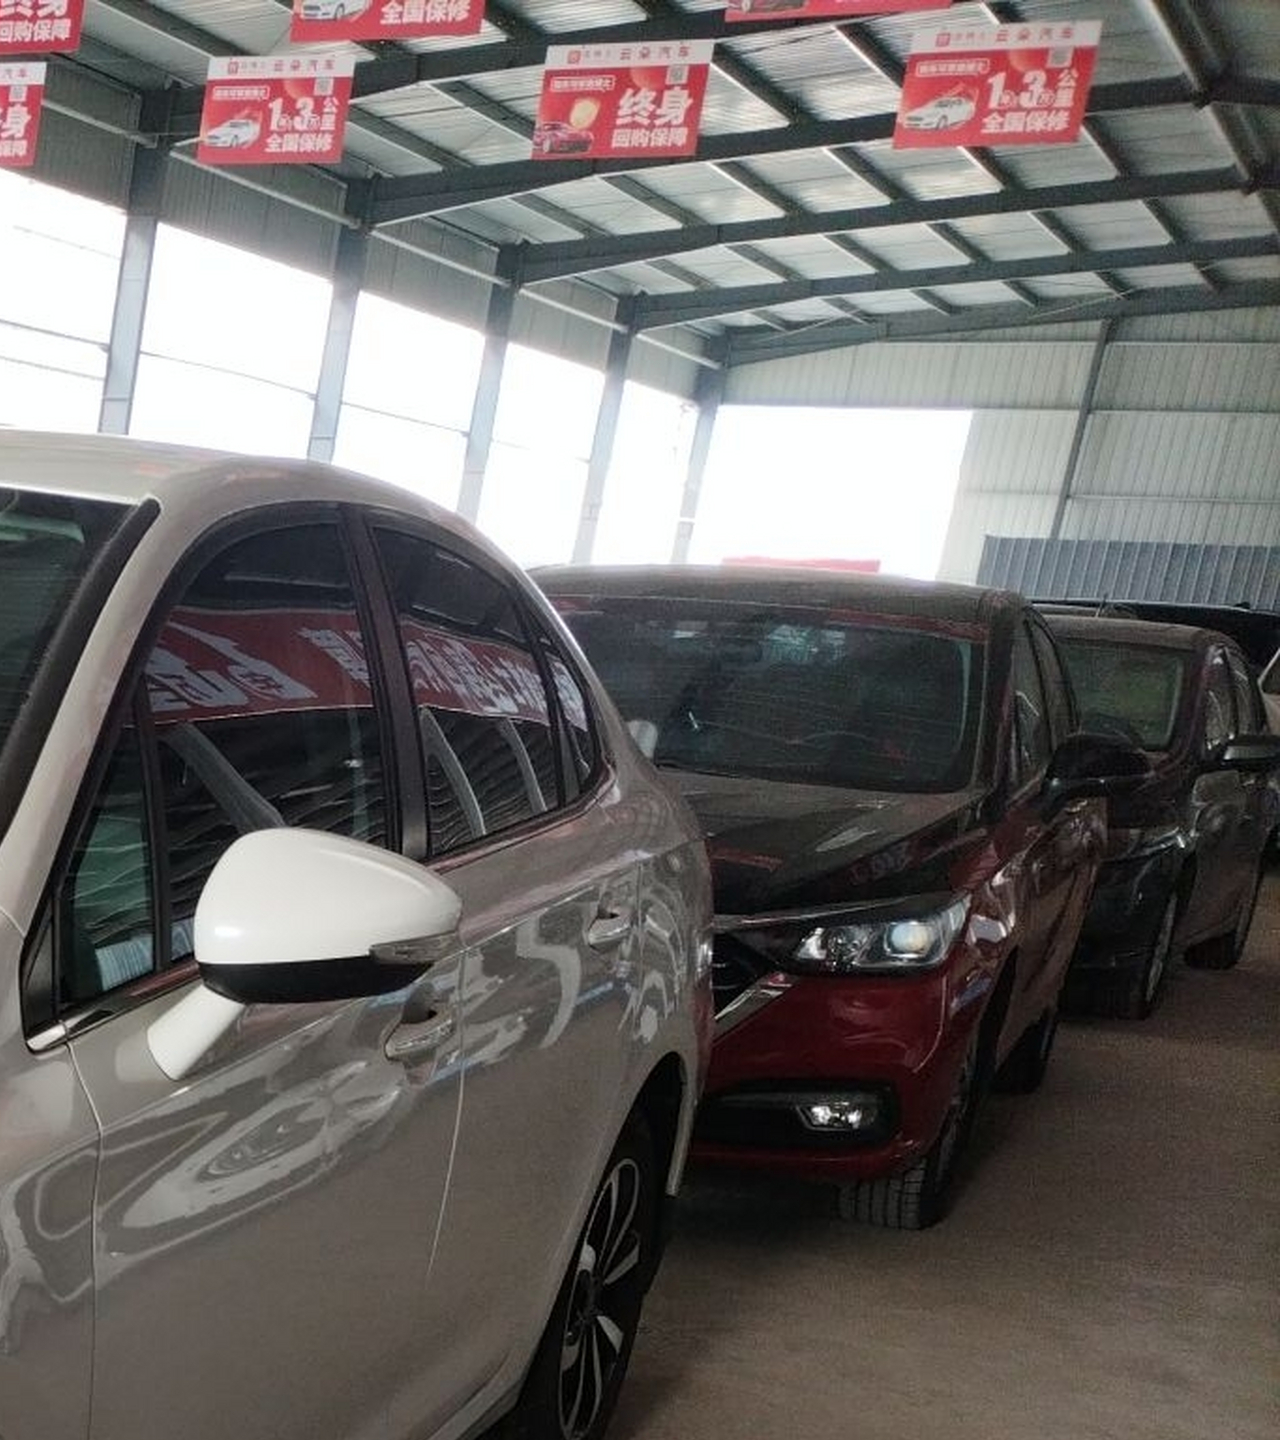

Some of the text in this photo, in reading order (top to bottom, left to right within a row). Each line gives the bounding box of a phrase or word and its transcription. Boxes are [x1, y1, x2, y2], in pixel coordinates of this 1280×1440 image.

[379, 0, 471, 25] 全国保修
[615, 86, 693, 126] 终身
[980, 110, 1072, 134] 全国保修
[264, 132, 334, 153] 全国保修
[611, 126, 689, 148] 回购保障
